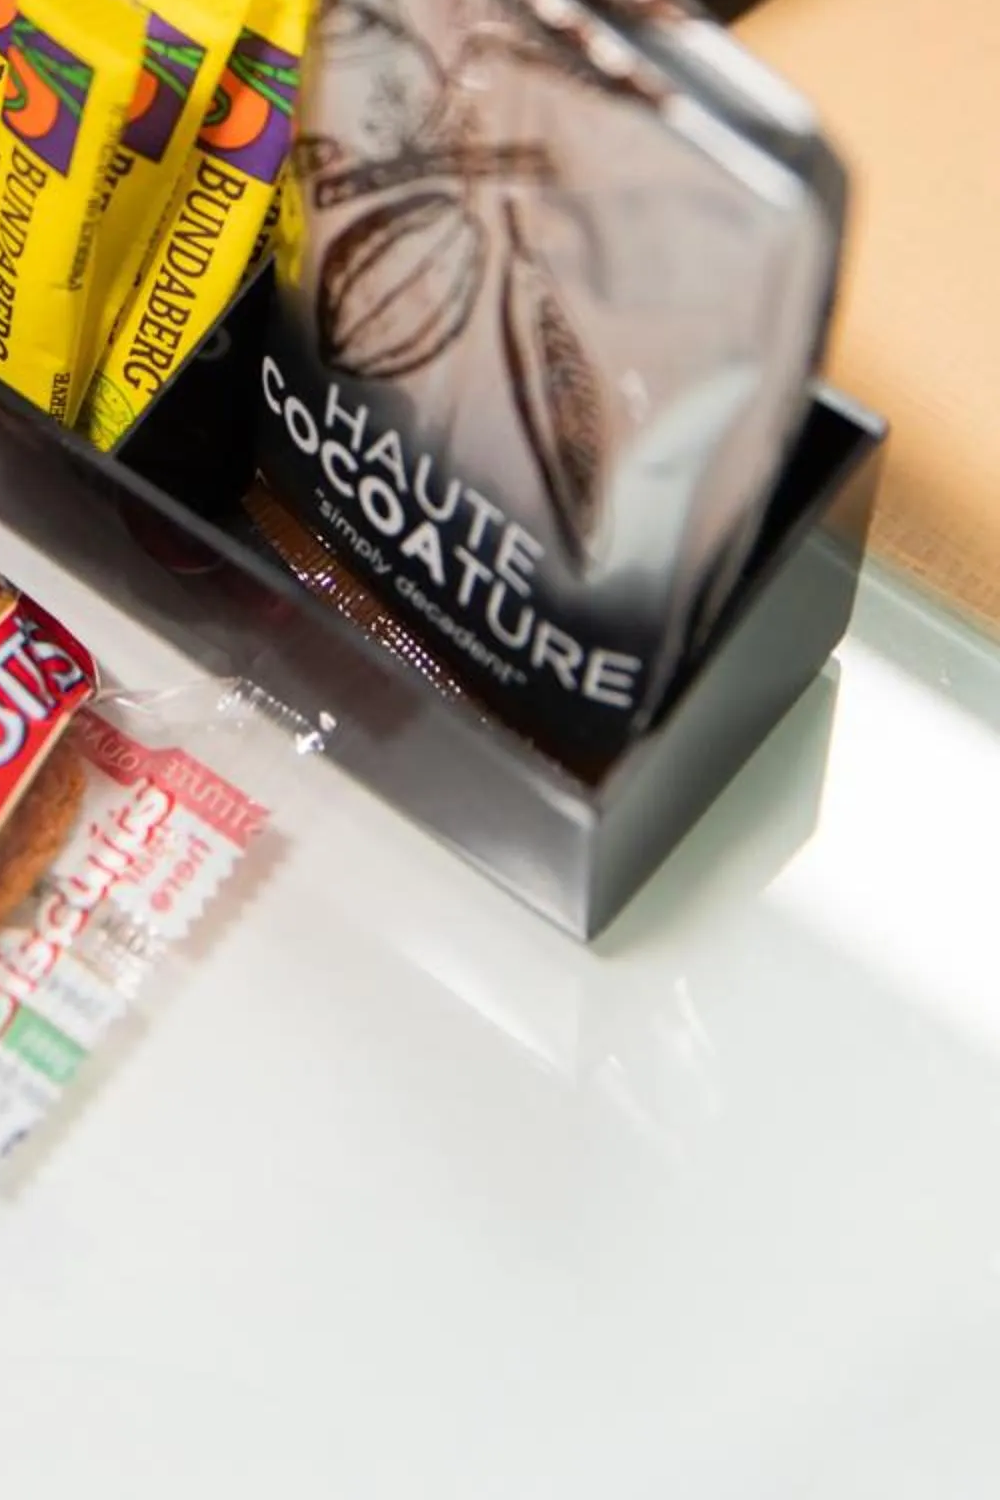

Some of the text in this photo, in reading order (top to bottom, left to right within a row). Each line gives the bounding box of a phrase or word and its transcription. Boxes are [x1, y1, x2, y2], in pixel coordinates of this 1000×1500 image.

[122, 156, 248, 395] BUNDABERG
[261, 355, 643, 710] COCOATURE
[325, 383, 546, 597] HAUTE
